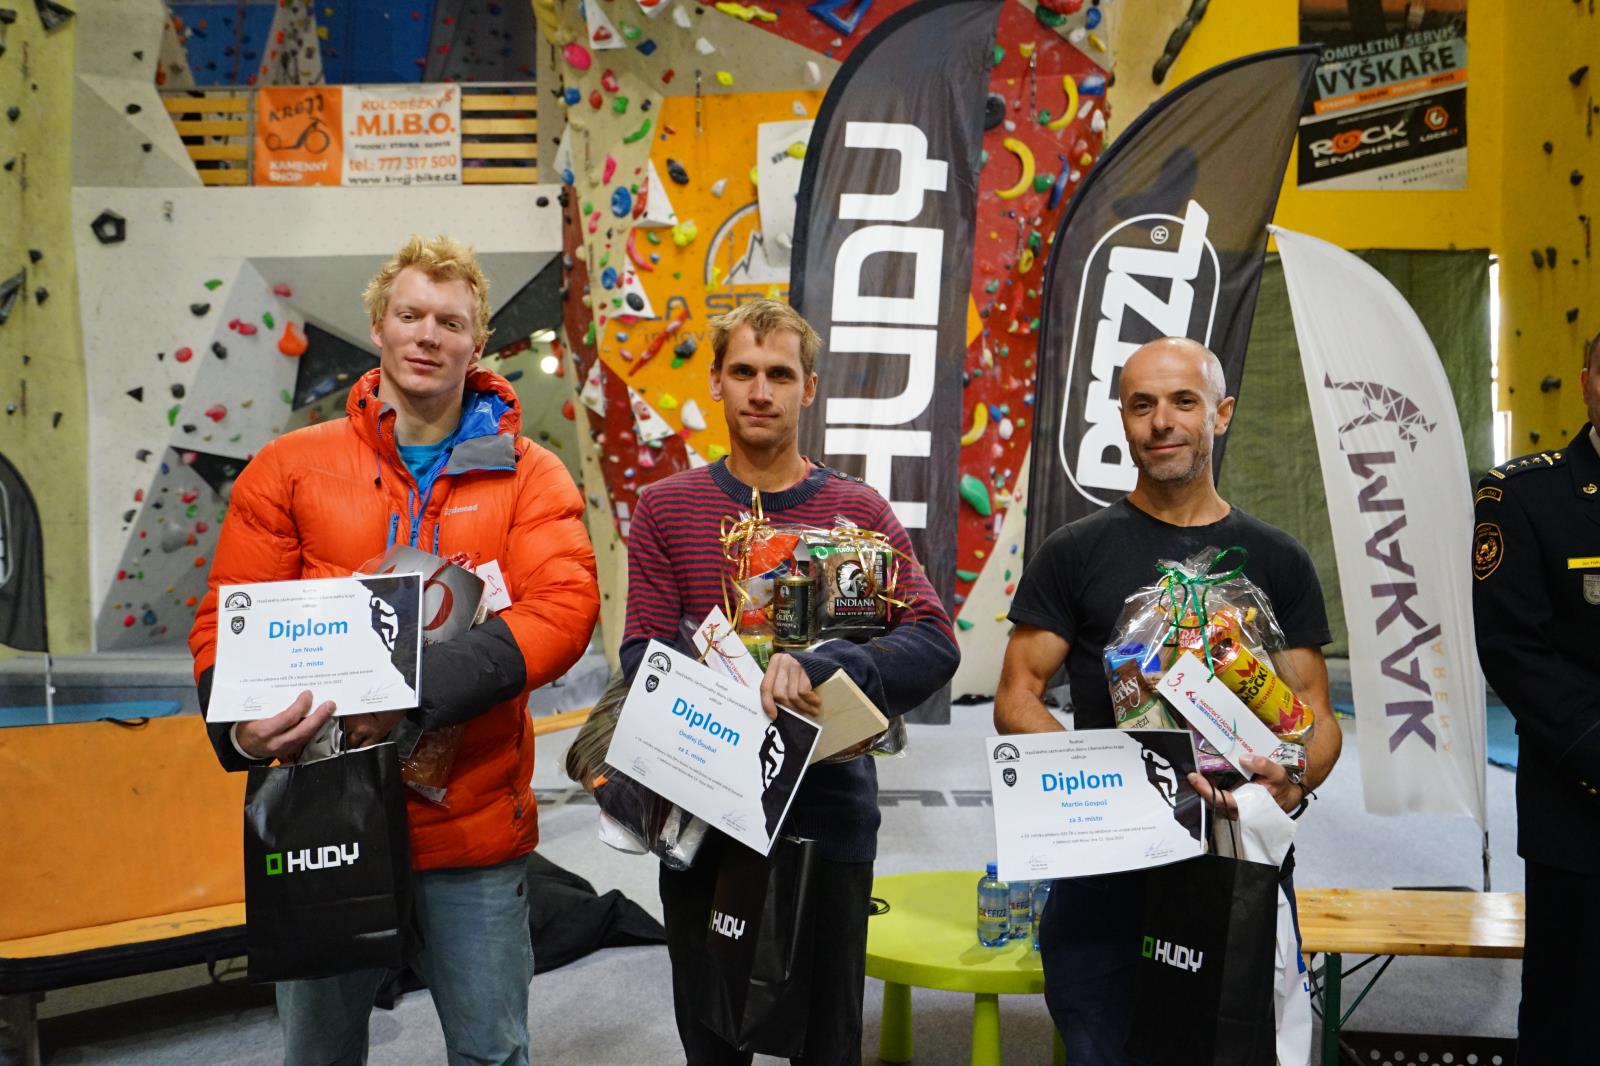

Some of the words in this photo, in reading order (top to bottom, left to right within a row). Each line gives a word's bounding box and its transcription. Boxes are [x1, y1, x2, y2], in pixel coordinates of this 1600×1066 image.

[1320, 35, 1399, 62] OMPLETNÍ
[1405, 26, 1458, 47] SERVIS
[1318, 45, 1456, 95] VÝŠKAŘE
[1309, 120, 1408, 158] ROCK
[1315, 141, 1409, 168] EMPIRE
[378, 157, 402, 171] 777
[406, 156, 428, 170] 317
[432, 154, 457, 169] 500
[824, 121, 948, 529] HUDY
[836, 598, 875, 607] INDIANA
[269, 618, 349, 641] Diplom
[1166, 672, 1185, 692] 3.
[1240, 666, 1269, 703] HOCK!
[671, 697, 741, 746] Diplom
[1041, 770, 1123, 794] Diplom
[287, 842, 360, 873] HUDY
[711, 910, 746, 940] HUDY
[1154, 939, 1204, 973] HUDY
